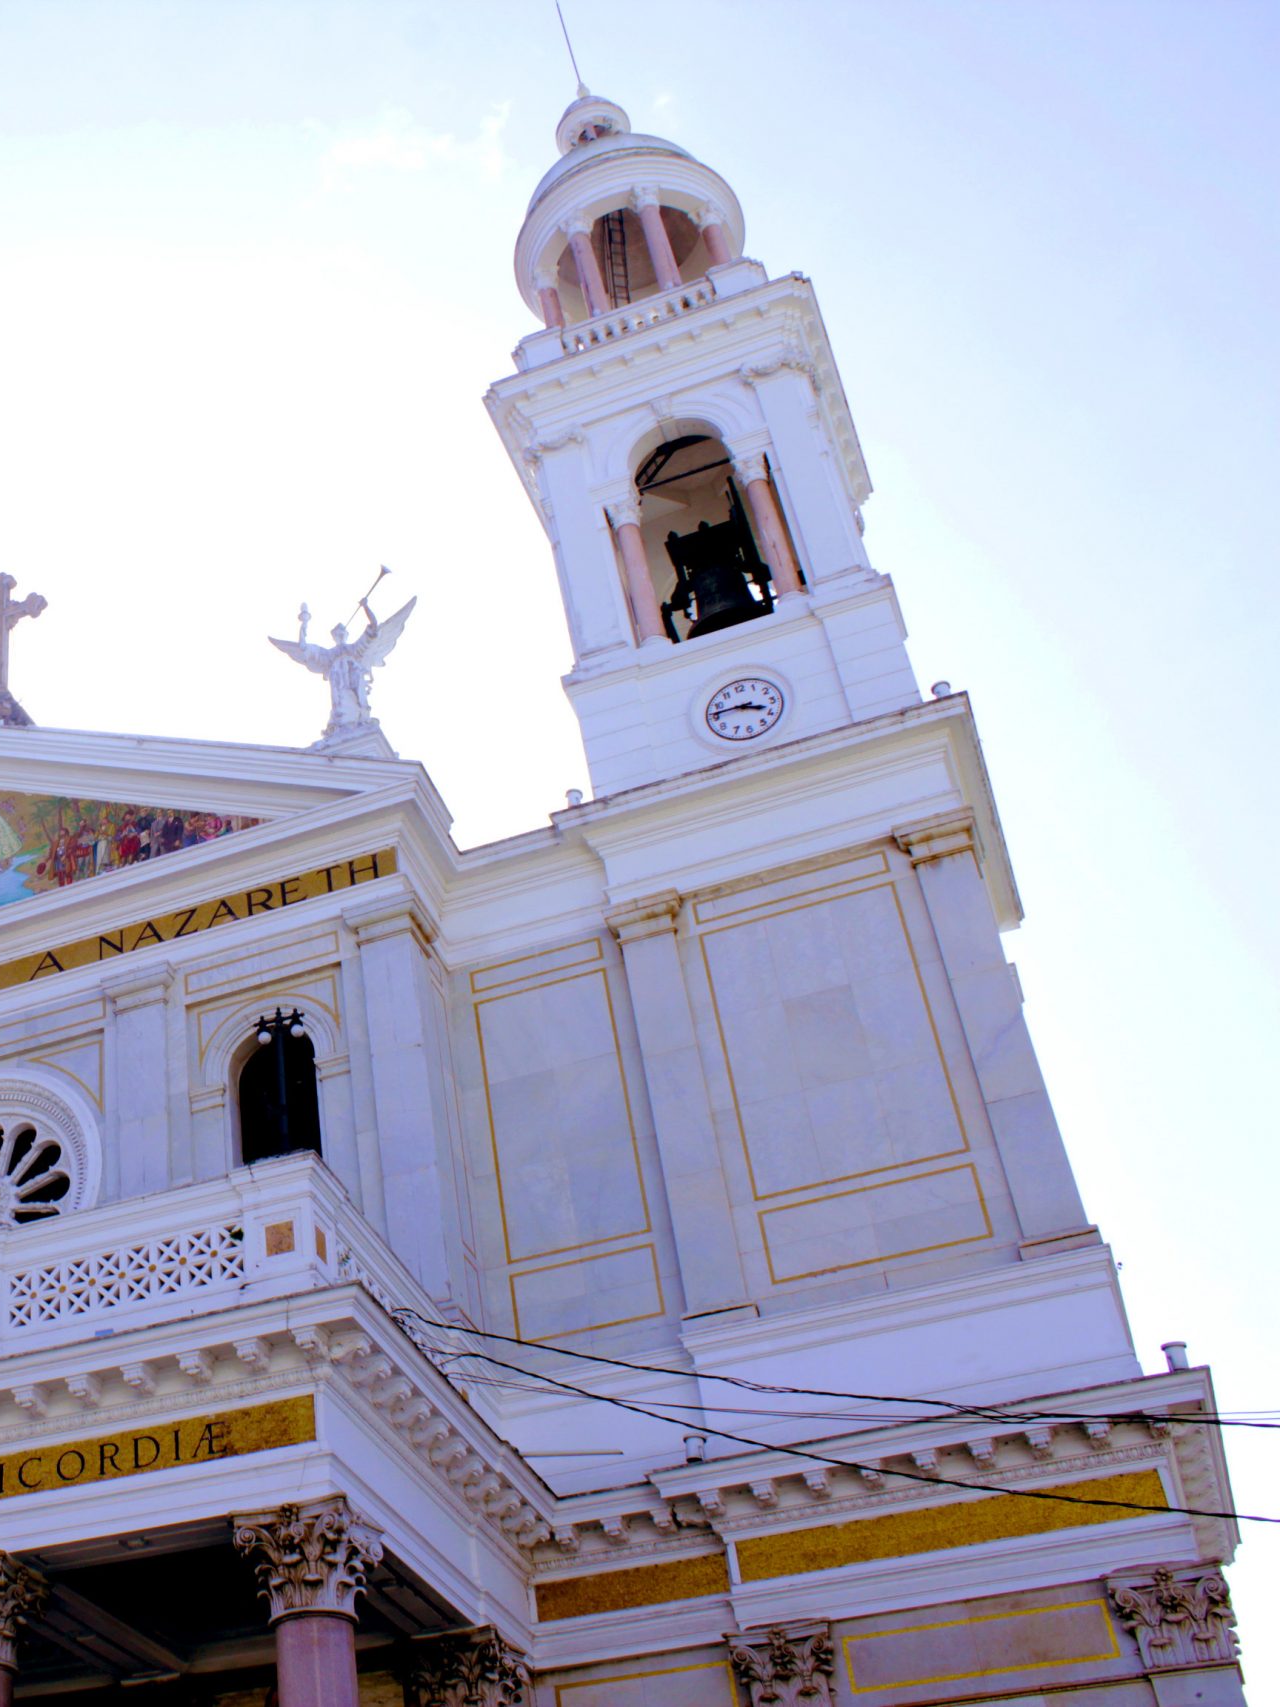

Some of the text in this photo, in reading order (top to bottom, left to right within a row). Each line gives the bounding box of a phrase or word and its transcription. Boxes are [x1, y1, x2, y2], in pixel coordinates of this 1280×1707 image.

[734, 685, 745, 693] 12
[762, 687, 769, 695] 2
[723, 692, 730, 700] 11
[768, 696, 776, 704] 3
[719, 722, 726, 730] 8
[733, 726, 740, 734] 7
[28, 950, 66, 981] A
[98, 853, 380, 960] NAZARETH
